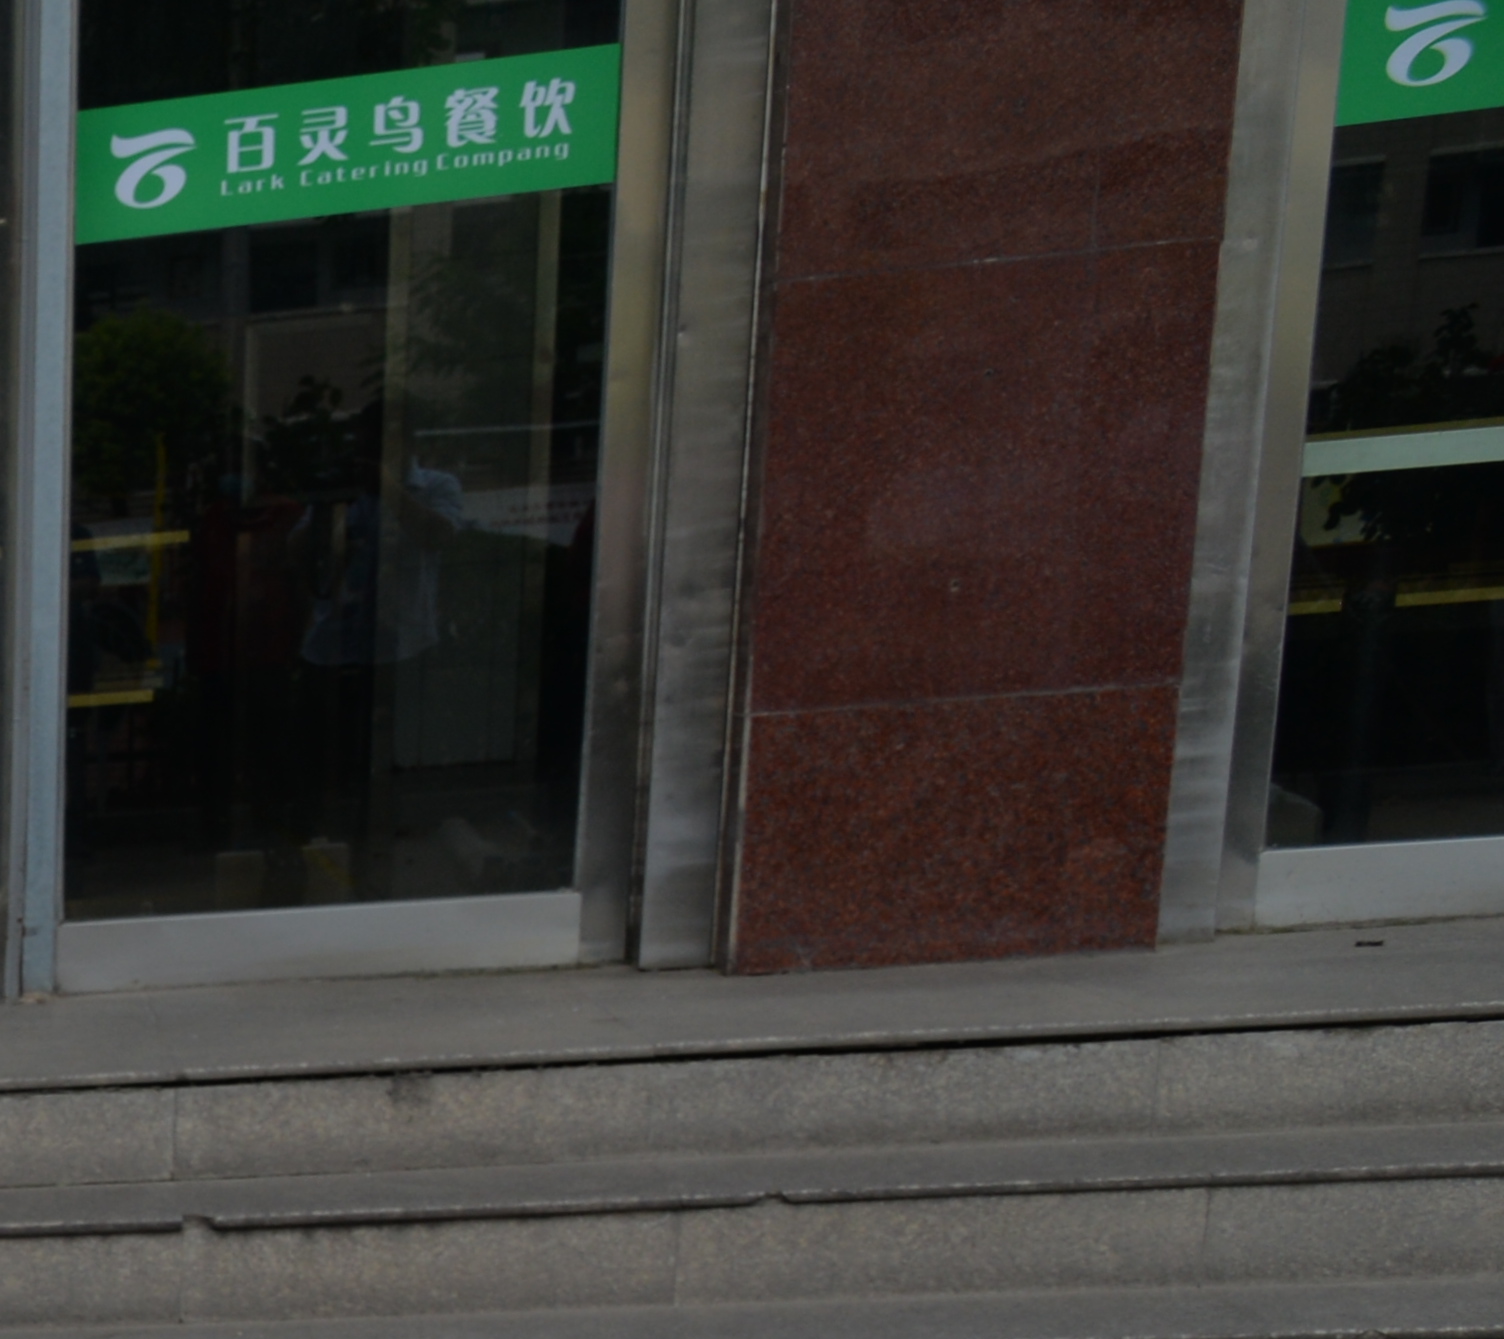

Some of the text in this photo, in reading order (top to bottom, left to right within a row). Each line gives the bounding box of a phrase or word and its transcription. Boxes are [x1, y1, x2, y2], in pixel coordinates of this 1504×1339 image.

[224, 78, 576, 174] 百灵鸟餐饮
[220, 173, 286, 196] Lark
[300, 158, 428, 188] Catering
